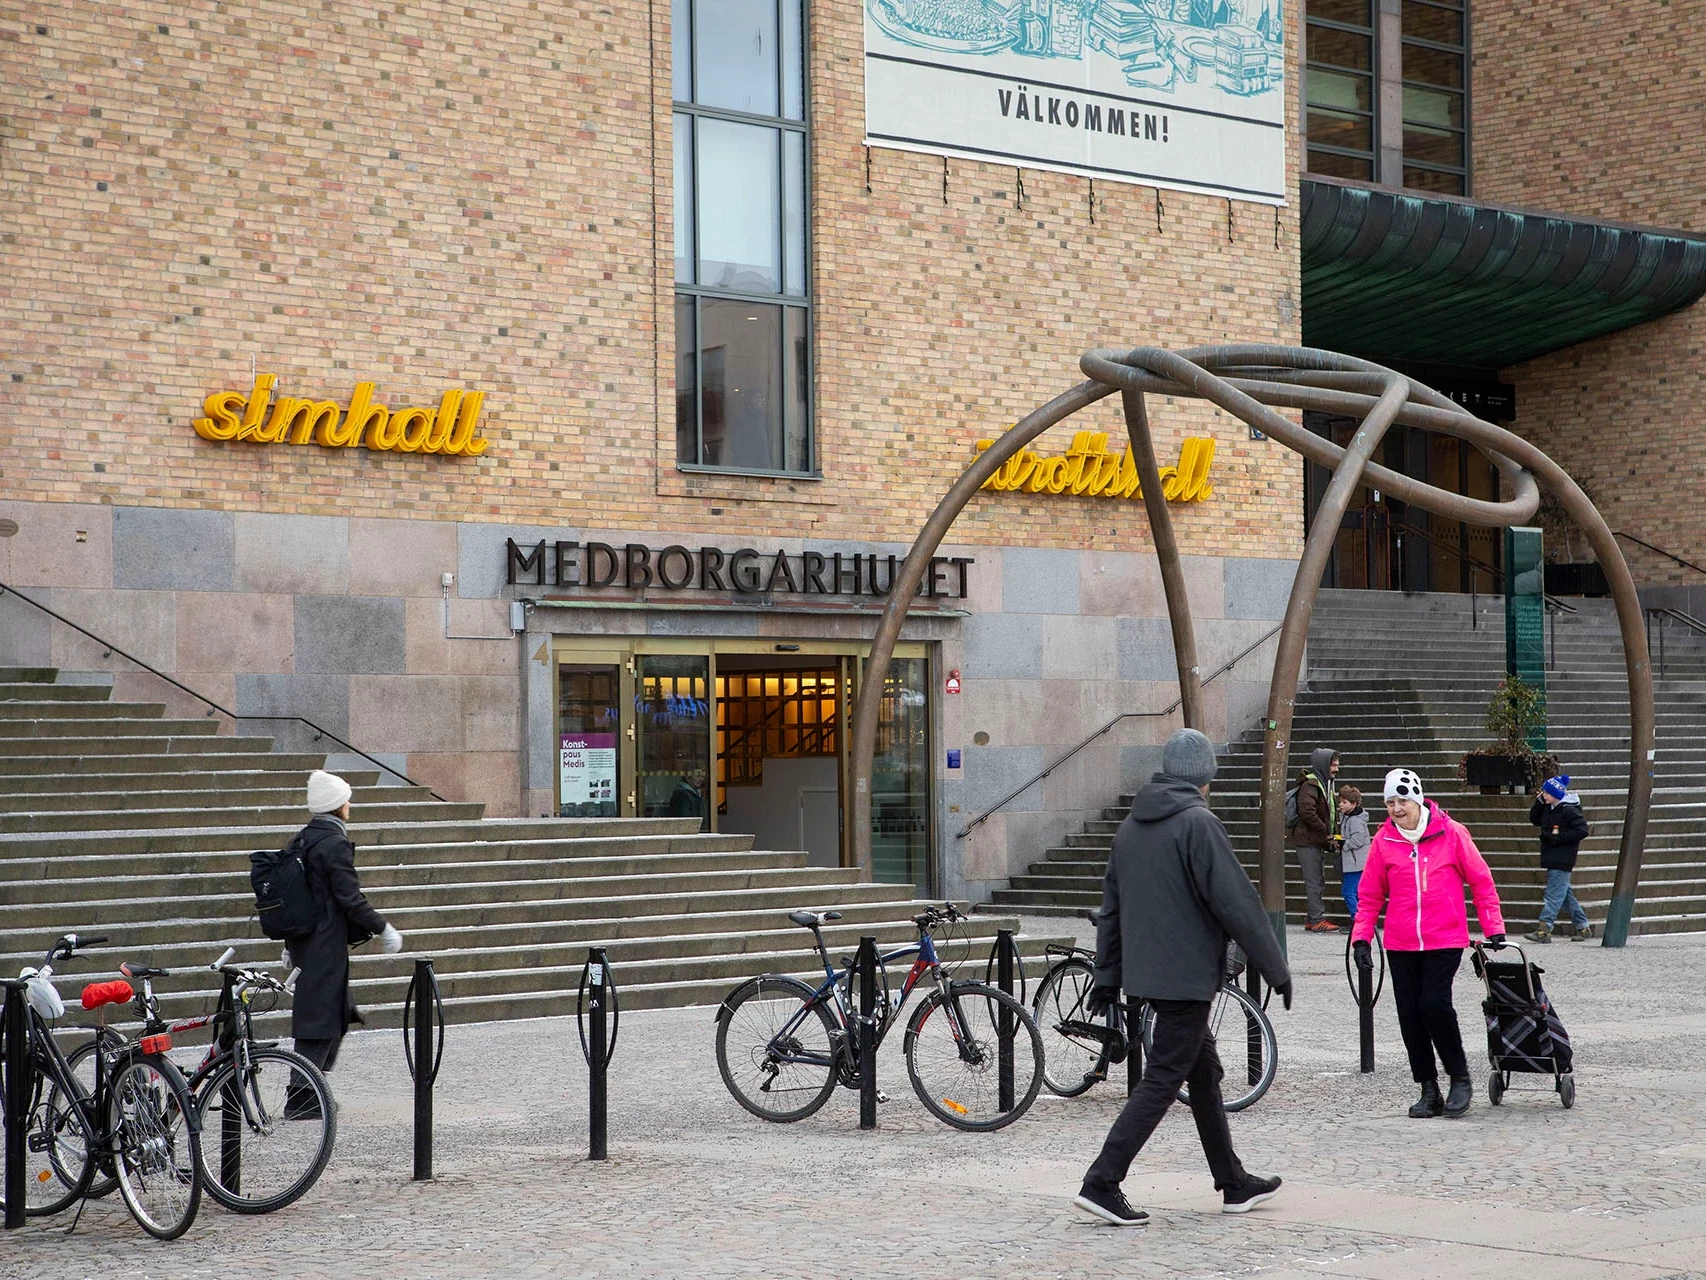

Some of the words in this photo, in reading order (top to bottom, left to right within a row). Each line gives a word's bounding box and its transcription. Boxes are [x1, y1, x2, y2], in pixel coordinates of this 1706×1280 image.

[998, 85, 1168, 143] VÄLKOMMEN!
[192, 373, 489, 456] simhall
[506, 537, 975, 598] MEDBORGARHUET
[562, 739, 588, 749] Konst-
[563, 751, 582, 760] paus
[563, 759, 586, 768] Medis
